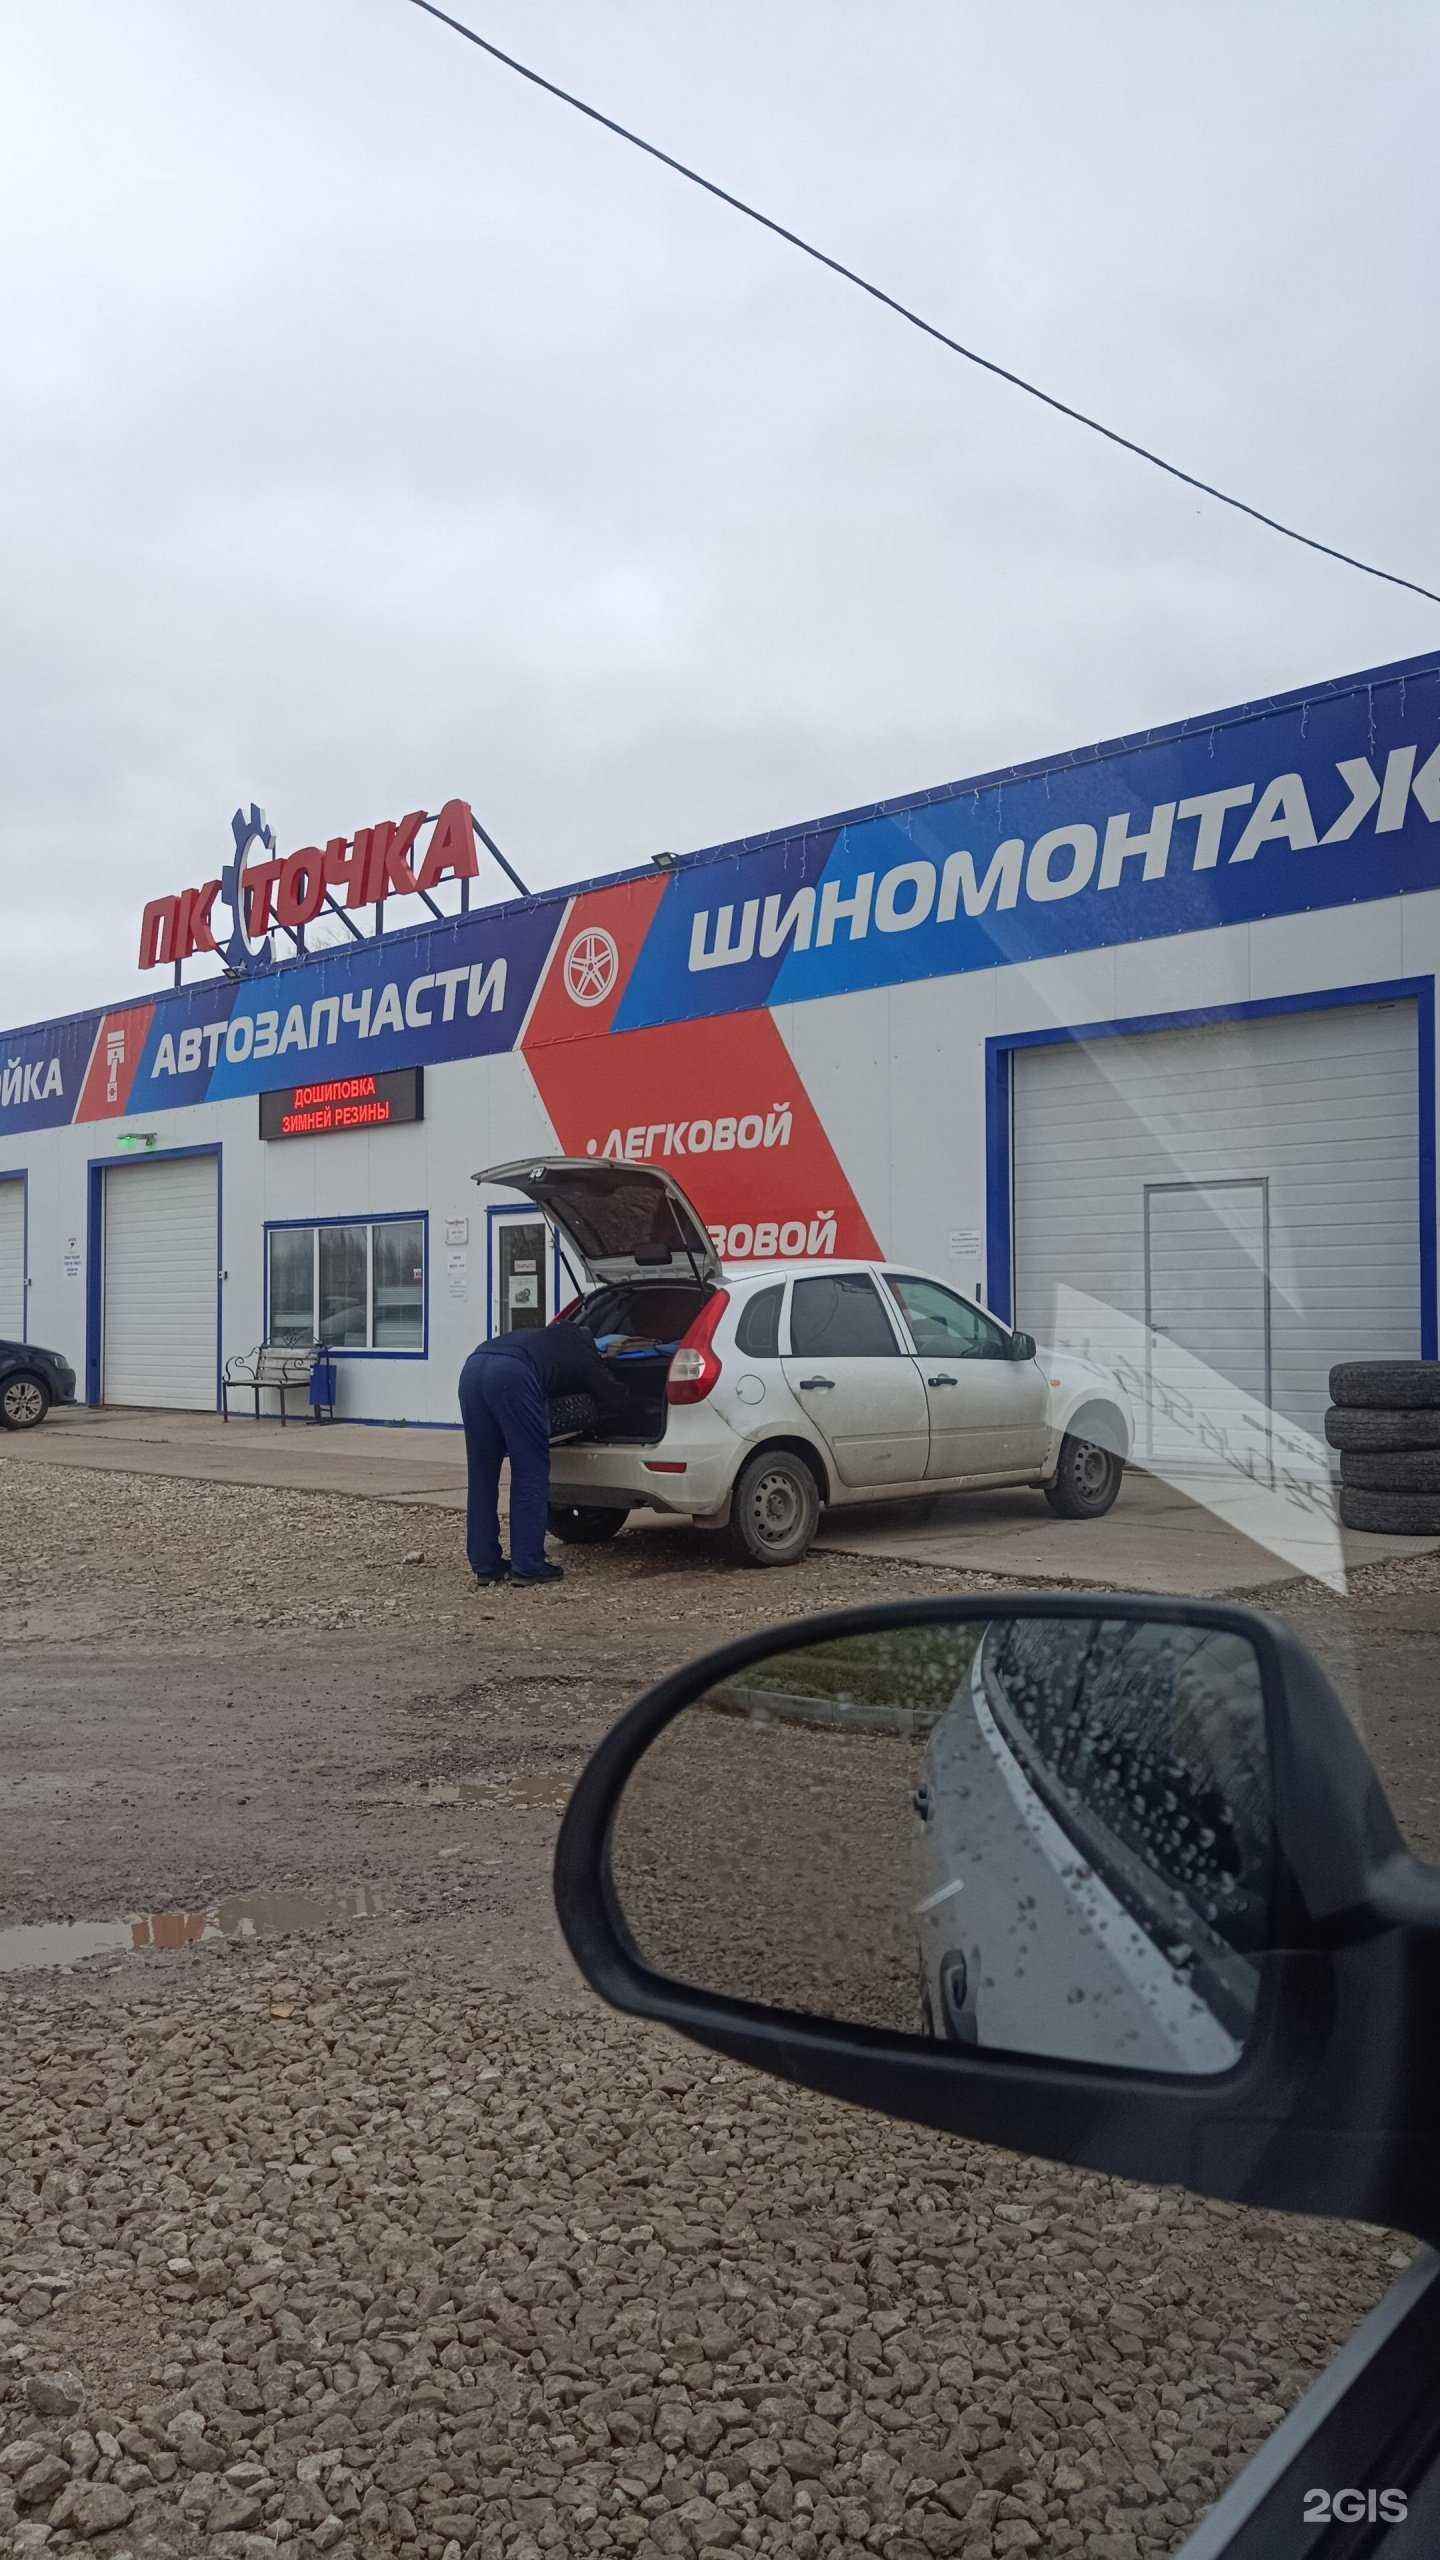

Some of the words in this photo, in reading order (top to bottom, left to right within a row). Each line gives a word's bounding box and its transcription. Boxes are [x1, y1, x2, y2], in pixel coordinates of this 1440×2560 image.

[138, 879, 224, 969] ПК
[243, 798, 479, 938] ТОЧКА
[688, 742, 1440, 972] ШИНОМОНТАЖ
[151, 958, 508, 1079] АВТОЗАПЧАСТИ
[0, 1056, 64, 1106] ЙКА
[294, 1077, 376, 1109] ДОШИПОВКА
[282, 1105, 333, 1133] ЗИМНЕЙ
[335, 1101, 390, 1127] РЕЗИНЫ
[601, 1102, 793, 1160] ЛЕГКОВОЙ
[707, 1209, 838, 1257] ЗОВОЙ
